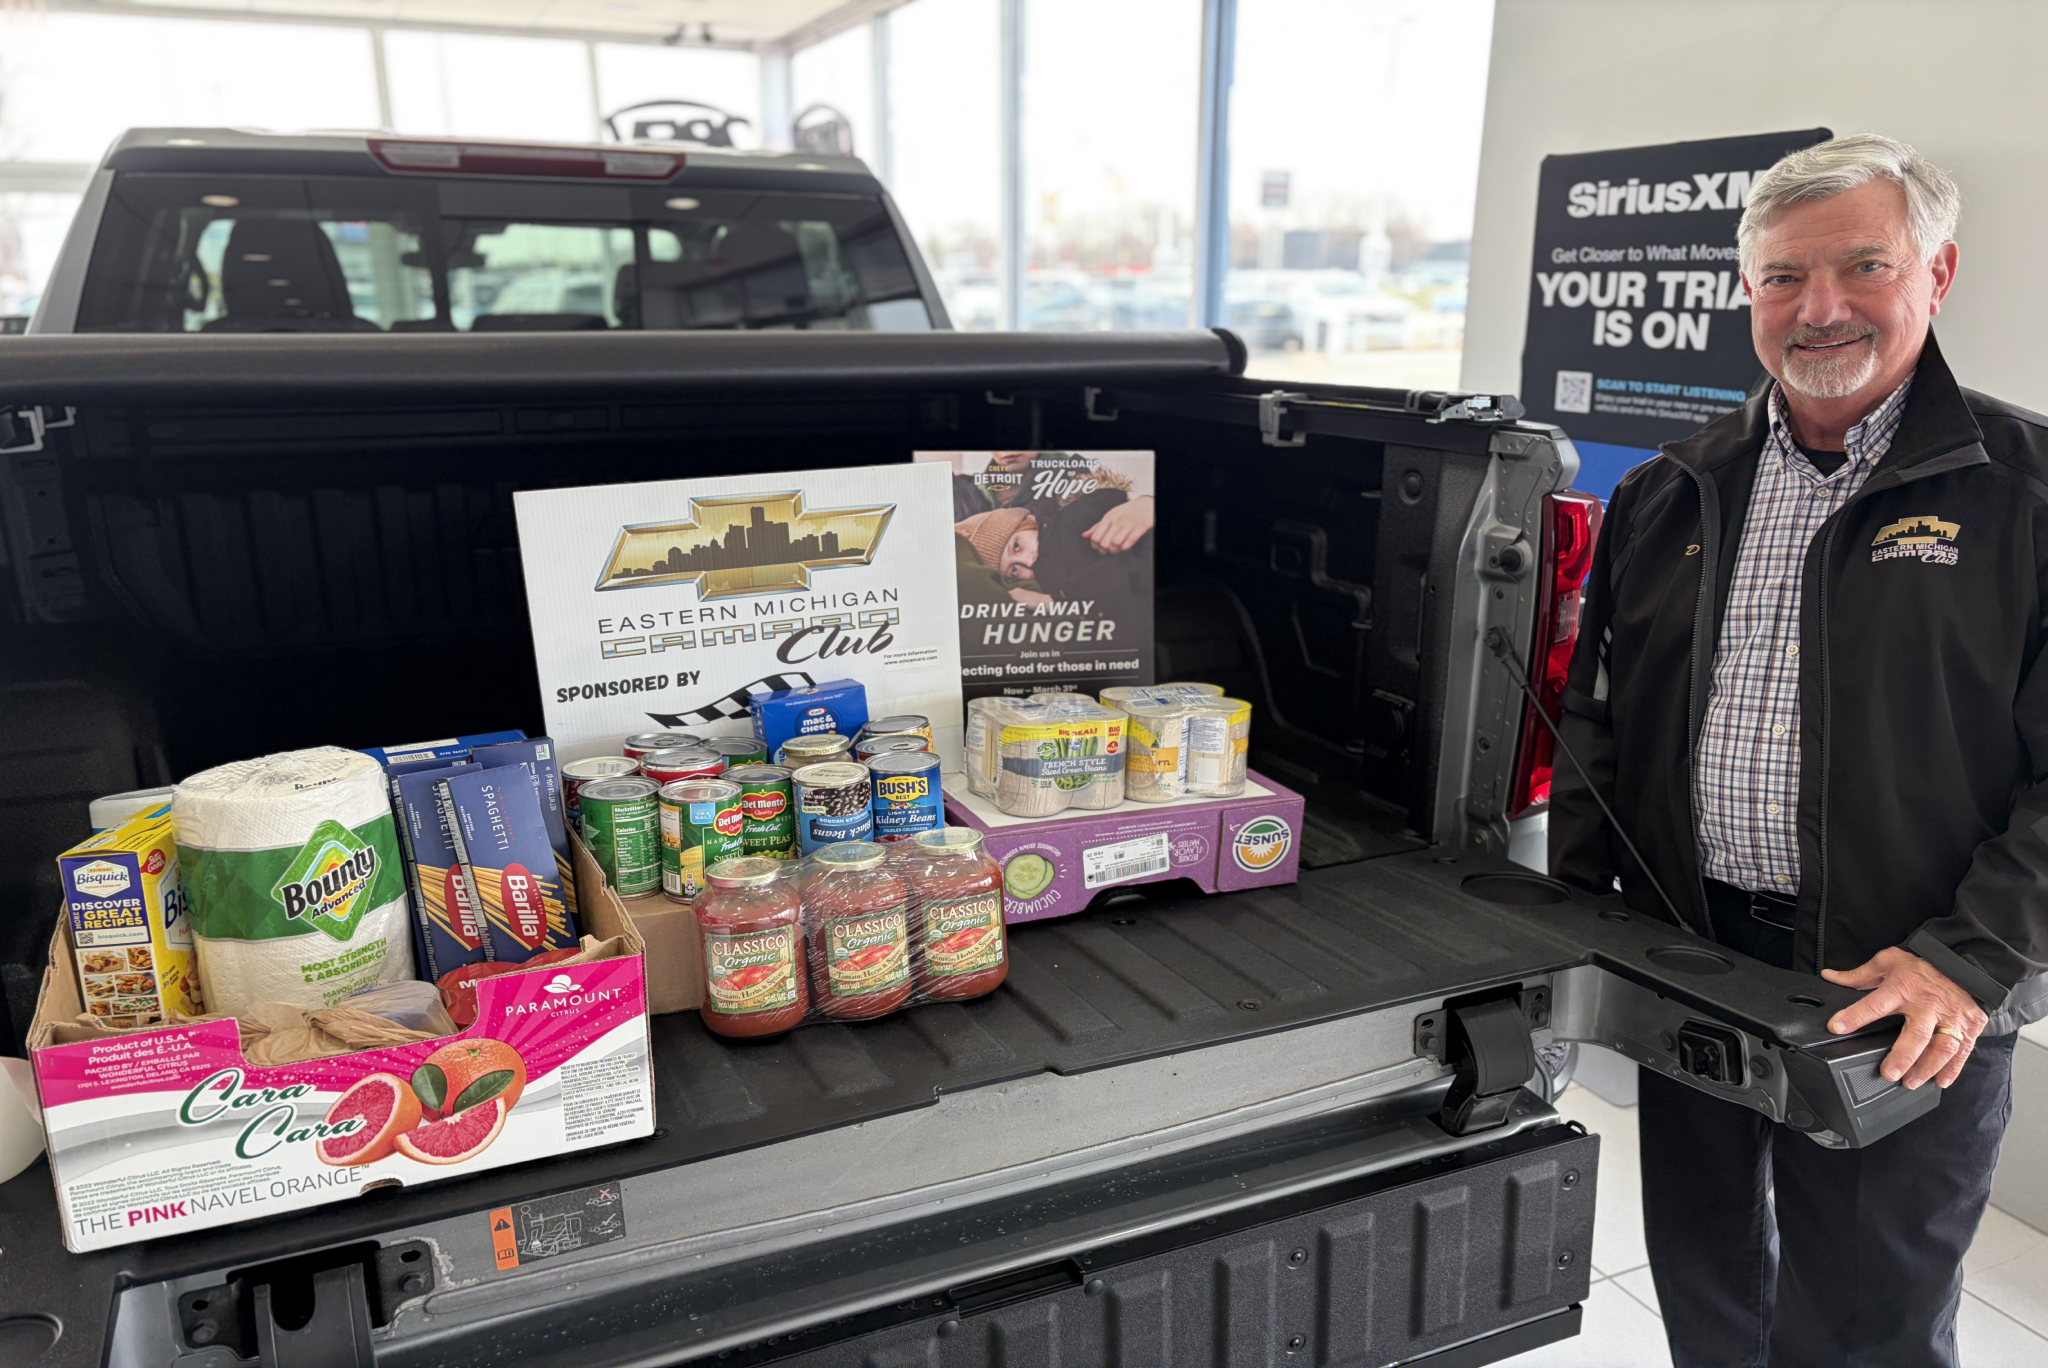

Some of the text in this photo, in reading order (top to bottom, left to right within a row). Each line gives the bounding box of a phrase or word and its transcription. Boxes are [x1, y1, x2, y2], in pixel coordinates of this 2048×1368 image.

[1551, 244, 1740, 264] Get Closer to What Moves
[1536, 271, 1752, 310] YOUR TRIA
[1593, 310, 1710, 350] IS ON
[1596, 378, 1747, 402] SCAN TO START LISTENING
[1030, 459, 1100, 469] TRUCKLOADS
[974, 473, 1023, 485] DETROIT
[1031, 469, 1099, 500] Hope
[1872, 543, 1959, 557] EASTERN MICHIGAN
[1921, 553, 1958, 566] Club
[598, 588, 899, 634] EASTERN MICHIGAN
[960, 600, 1095, 619] DRIVE AWAY
[600, 607, 900, 660] CAMARO
[983, 620, 1116, 645] HUNGER
[776, 622, 894, 665] Club
[1019, 650, 1038, 659] Join
[961, 658, 1139, 677] ecting food for those in need
[556, 670, 701, 704] SPONSORED BY
[1003, 687, 1024, 696] Now
[1033, 685, 1061, 694] March
[803, 714, 833, 727] mac &
[1072, 728, 1098, 736] DEAL!
[1042, 767, 1061, 776] Sliced
[1062, 766, 1083, 774] Green
[1043, 758, 1107, 769] FRENCH STYLE
[879, 780, 927, 796] BUSH'S
[614, 805, 645, 813] Nutrition
[742, 799, 784, 809] Del Monte
[481, 785, 510, 850] SPAGHETTI
[718, 816, 731, 828] Del
[875, 814, 937, 826] Kidney Beans
[745, 823, 782, 833] Fresh Cut
[813, 819, 871, 839] Black Beans
[1234, 828, 1290, 846] SUNSET
[707, 837, 728, 845] MADE
[743, 834, 791, 847] WEET PEAS
[1177, 838, 1200, 848] MATTERS
[1174, 845, 1203, 856] FLAVOR
[1178, 853, 1199, 863] BECAUSE
[76, 870, 129, 885] Bisquick
[281, 845, 376, 920] Bounty
[71, 898, 141, 911] DISCOVER
[311, 879, 366, 919] Advanced
[506, 874, 538, 938] Barilla
[84, 907, 142, 920] GREAT
[929, 898, 996, 920] CLASSICO
[74, 911, 82, 929] MORE
[84, 917, 144, 929] RECIPES
[834, 913, 901, 938] CLASSICO
[941, 915, 987, 931] Organic
[97, 931, 144, 940] bisquick.com
[847, 931, 895, 949] Organic
[713, 934, 786, 956] CLASSICO
[301, 937, 387, 974] MOST STRENGTH
[725, 952, 776, 968] Organic
[956, 949, 975, 961] Herbs
[304, 947, 389, 983] & ABSORBENCY
[863, 966, 883, 978] Herbs
[741, 987, 762, 999] Herbs
[505, 988, 622, 1018] PARAMOUNT
[550, 1008, 580, 1018] CITRUS
[92, 1033, 188, 1055] Product of U.S.A.
[88, 1042, 196, 1066] Produit des É.-U.A.
[84, 1052, 200, 1076] PACKED BY EMBALLÉ PAR
[98, 1060, 189, 1079] WONDERFUL CITRUS
[100, 1074, 145, 1086] LEXINGTON,
[146, 1068, 179, 1079] DELANO,
[179, 1065, 191, 1073] CA
[191, 1062, 212, 1072] 93215
[110, 1074, 182, 1090] wonderfulcitrus.com
[179, 1068, 312, 1125] Cara
[235, 1105, 364, 1160] Cara
[93, 1176, 126, 1187] Wonderful
[171, 1164, 191, 1173] Rights
[74, 1212, 123, 1236] THE
[127, 1201, 188, 1227] PINK
[190, 1185, 267, 1214] NAVEL
